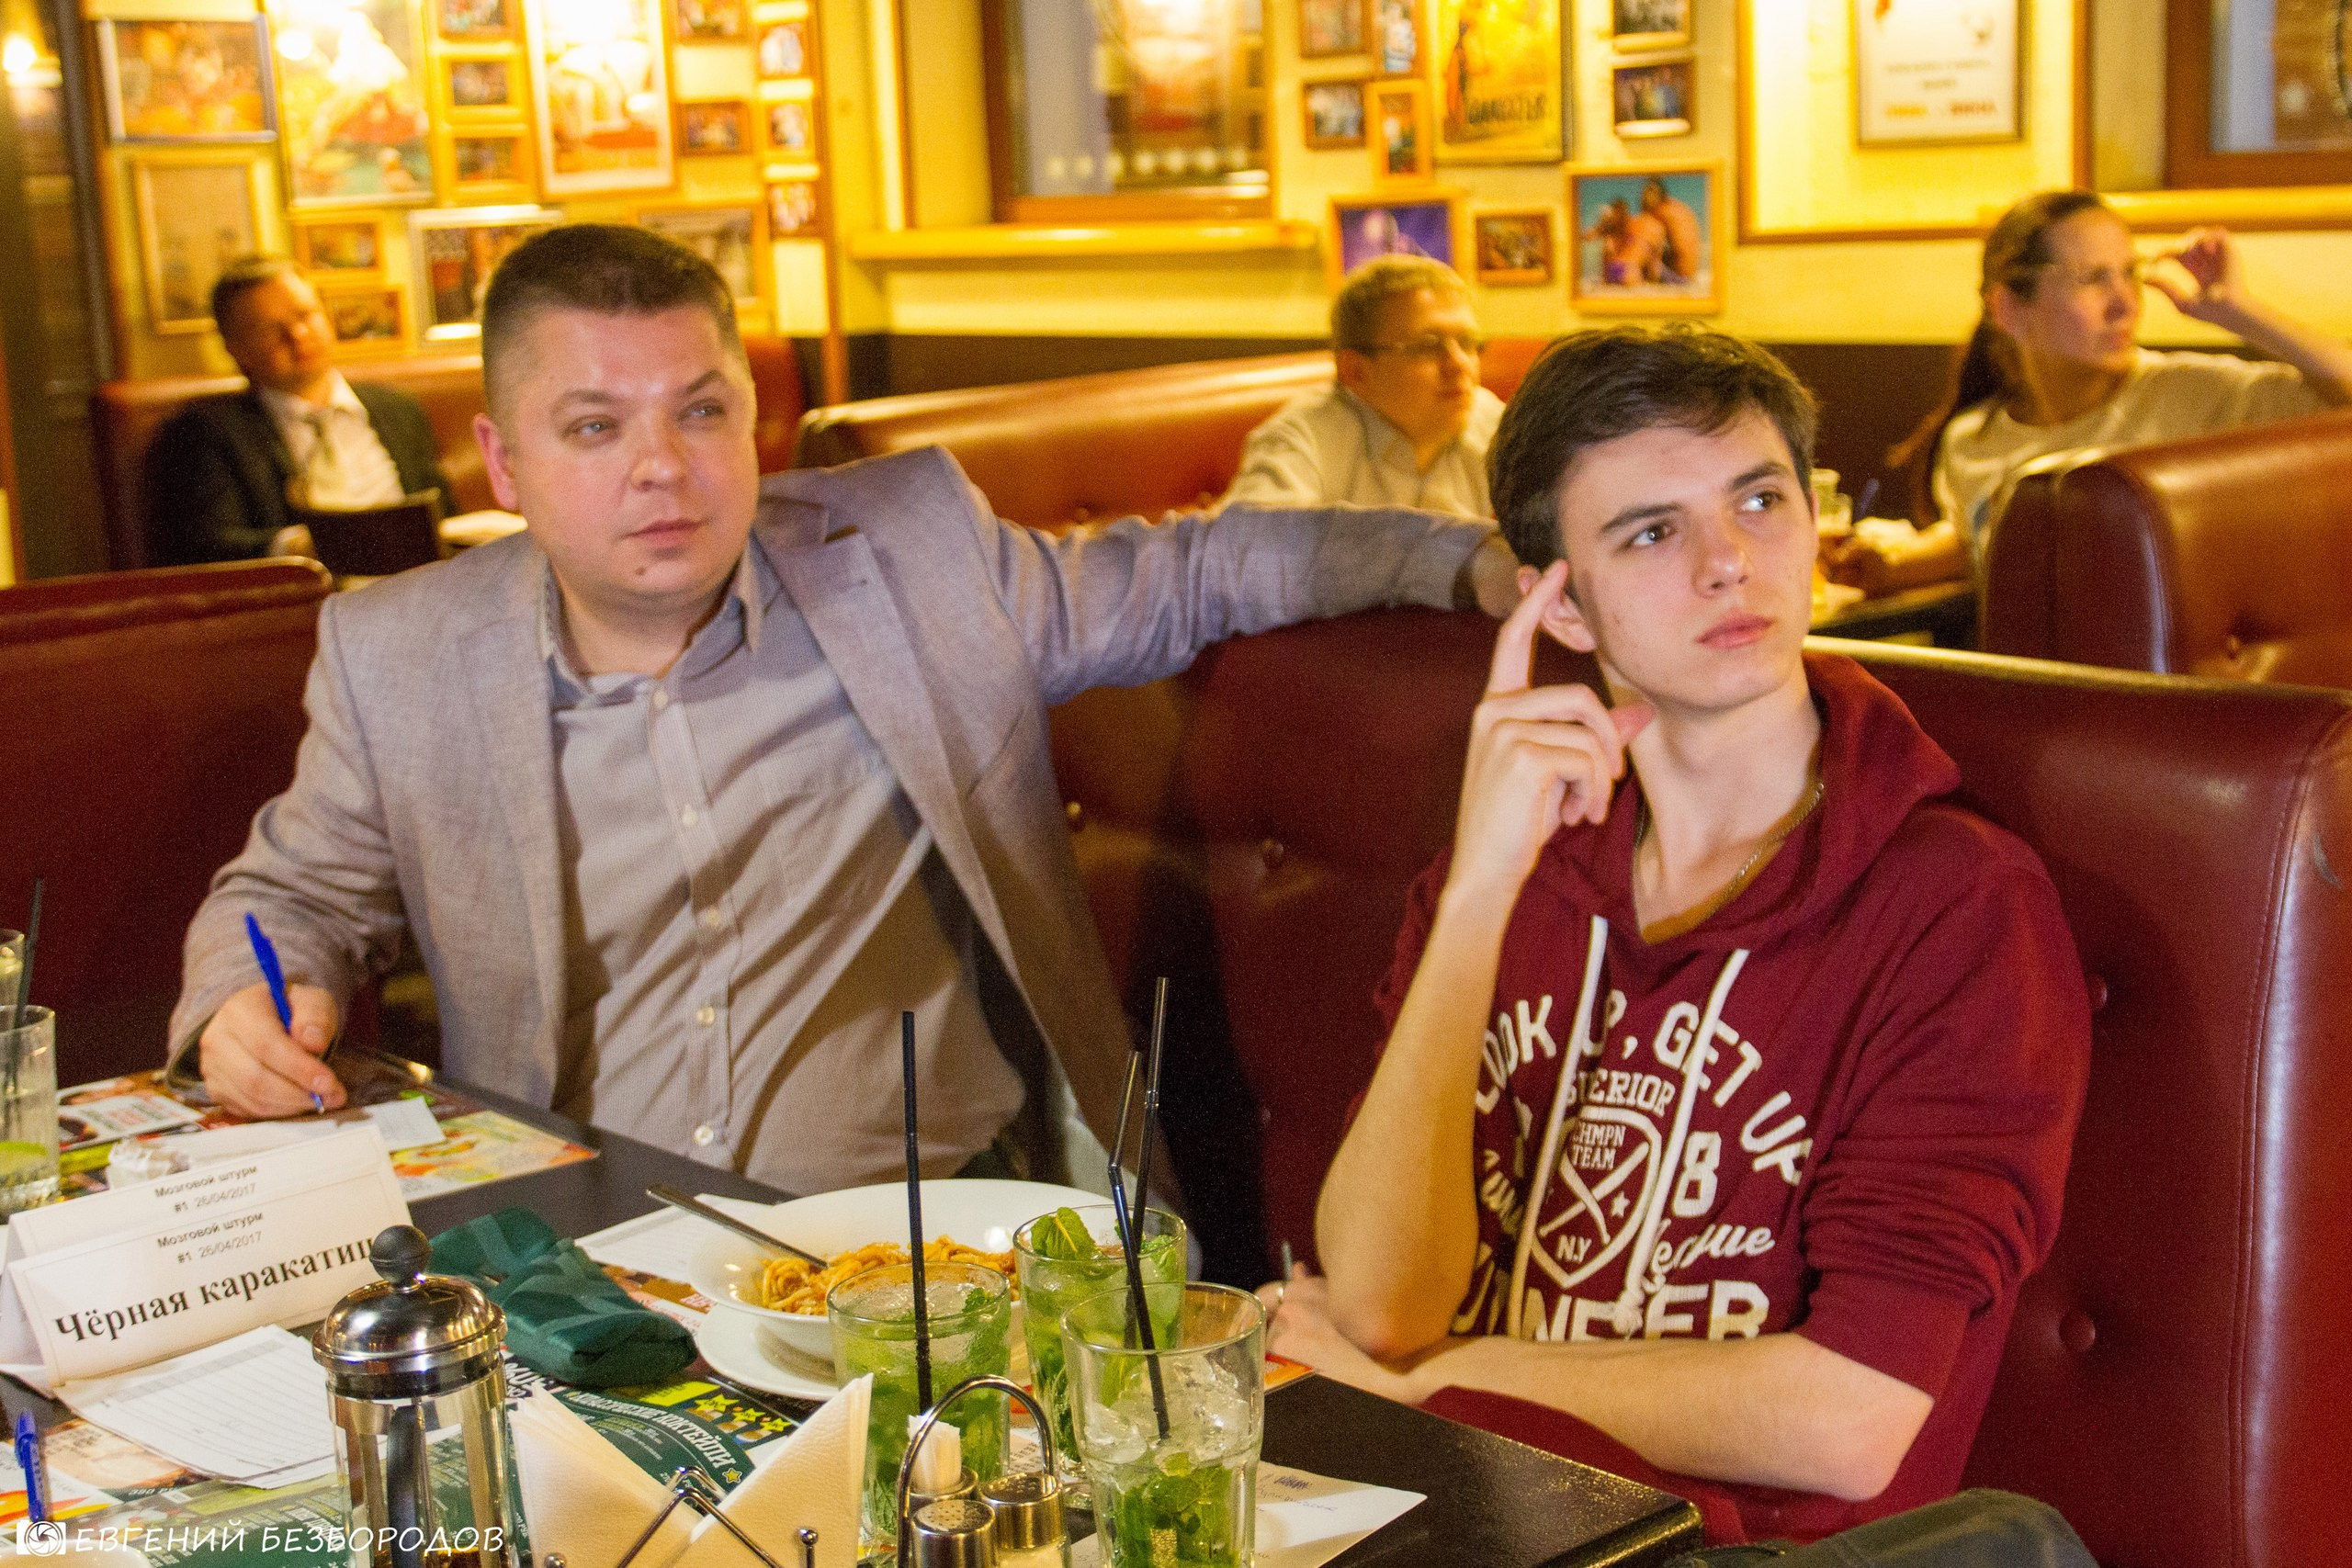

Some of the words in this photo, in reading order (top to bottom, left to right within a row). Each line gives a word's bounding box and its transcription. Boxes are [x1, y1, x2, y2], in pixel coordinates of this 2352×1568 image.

[1655, 1001, 1762, 1107] GET
[1572, 1145, 1617, 1170] TEAM
[154, 1175, 216, 1198] Мозговой
[219, 1166, 257, 1182] штурм
[157, 1223, 220, 1248] Мозговой
[222, 1213, 263, 1228] штурм
[177, 1251, 192, 1263] #1
[54, 1290, 190, 1341] Чёрная
[199, 1237, 373, 1305] каракатиц
[652, 1413, 737, 1469] КОКТЕЙЛИ
